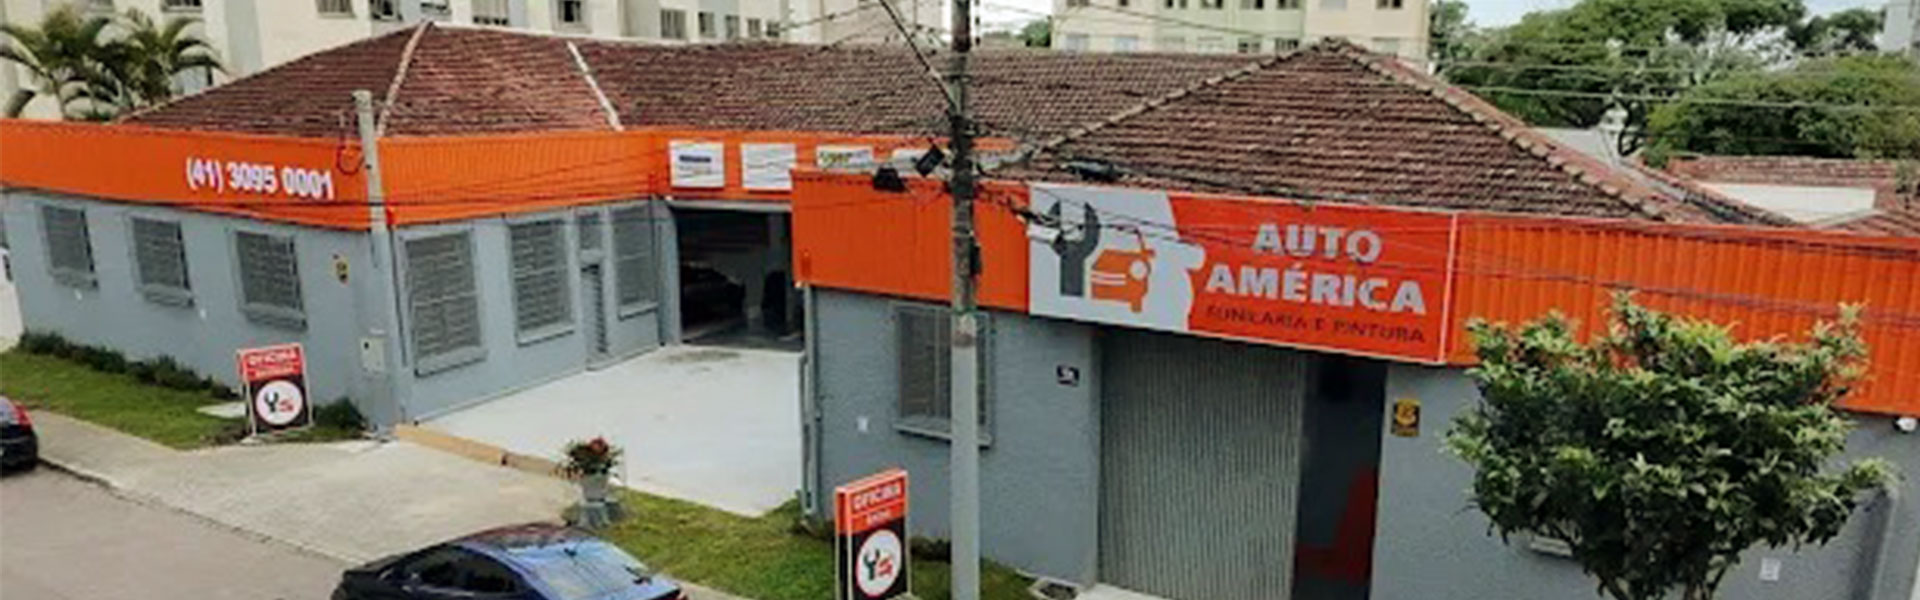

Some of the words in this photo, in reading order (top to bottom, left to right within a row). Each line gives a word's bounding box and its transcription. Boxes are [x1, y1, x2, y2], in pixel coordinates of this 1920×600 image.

[186, 156, 224, 195] (41)
[226, 161, 279, 194] 3095
[281, 166, 334, 200] 0001
[1253, 223, 1382, 263] AUTO
[1205, 260, 1427, 316] AMÉRICA
[1314, 318, 1325, 332] E
[1333, 319, 1426, 343] PINTURA
[852, 482, 901, 511] OFICINA
